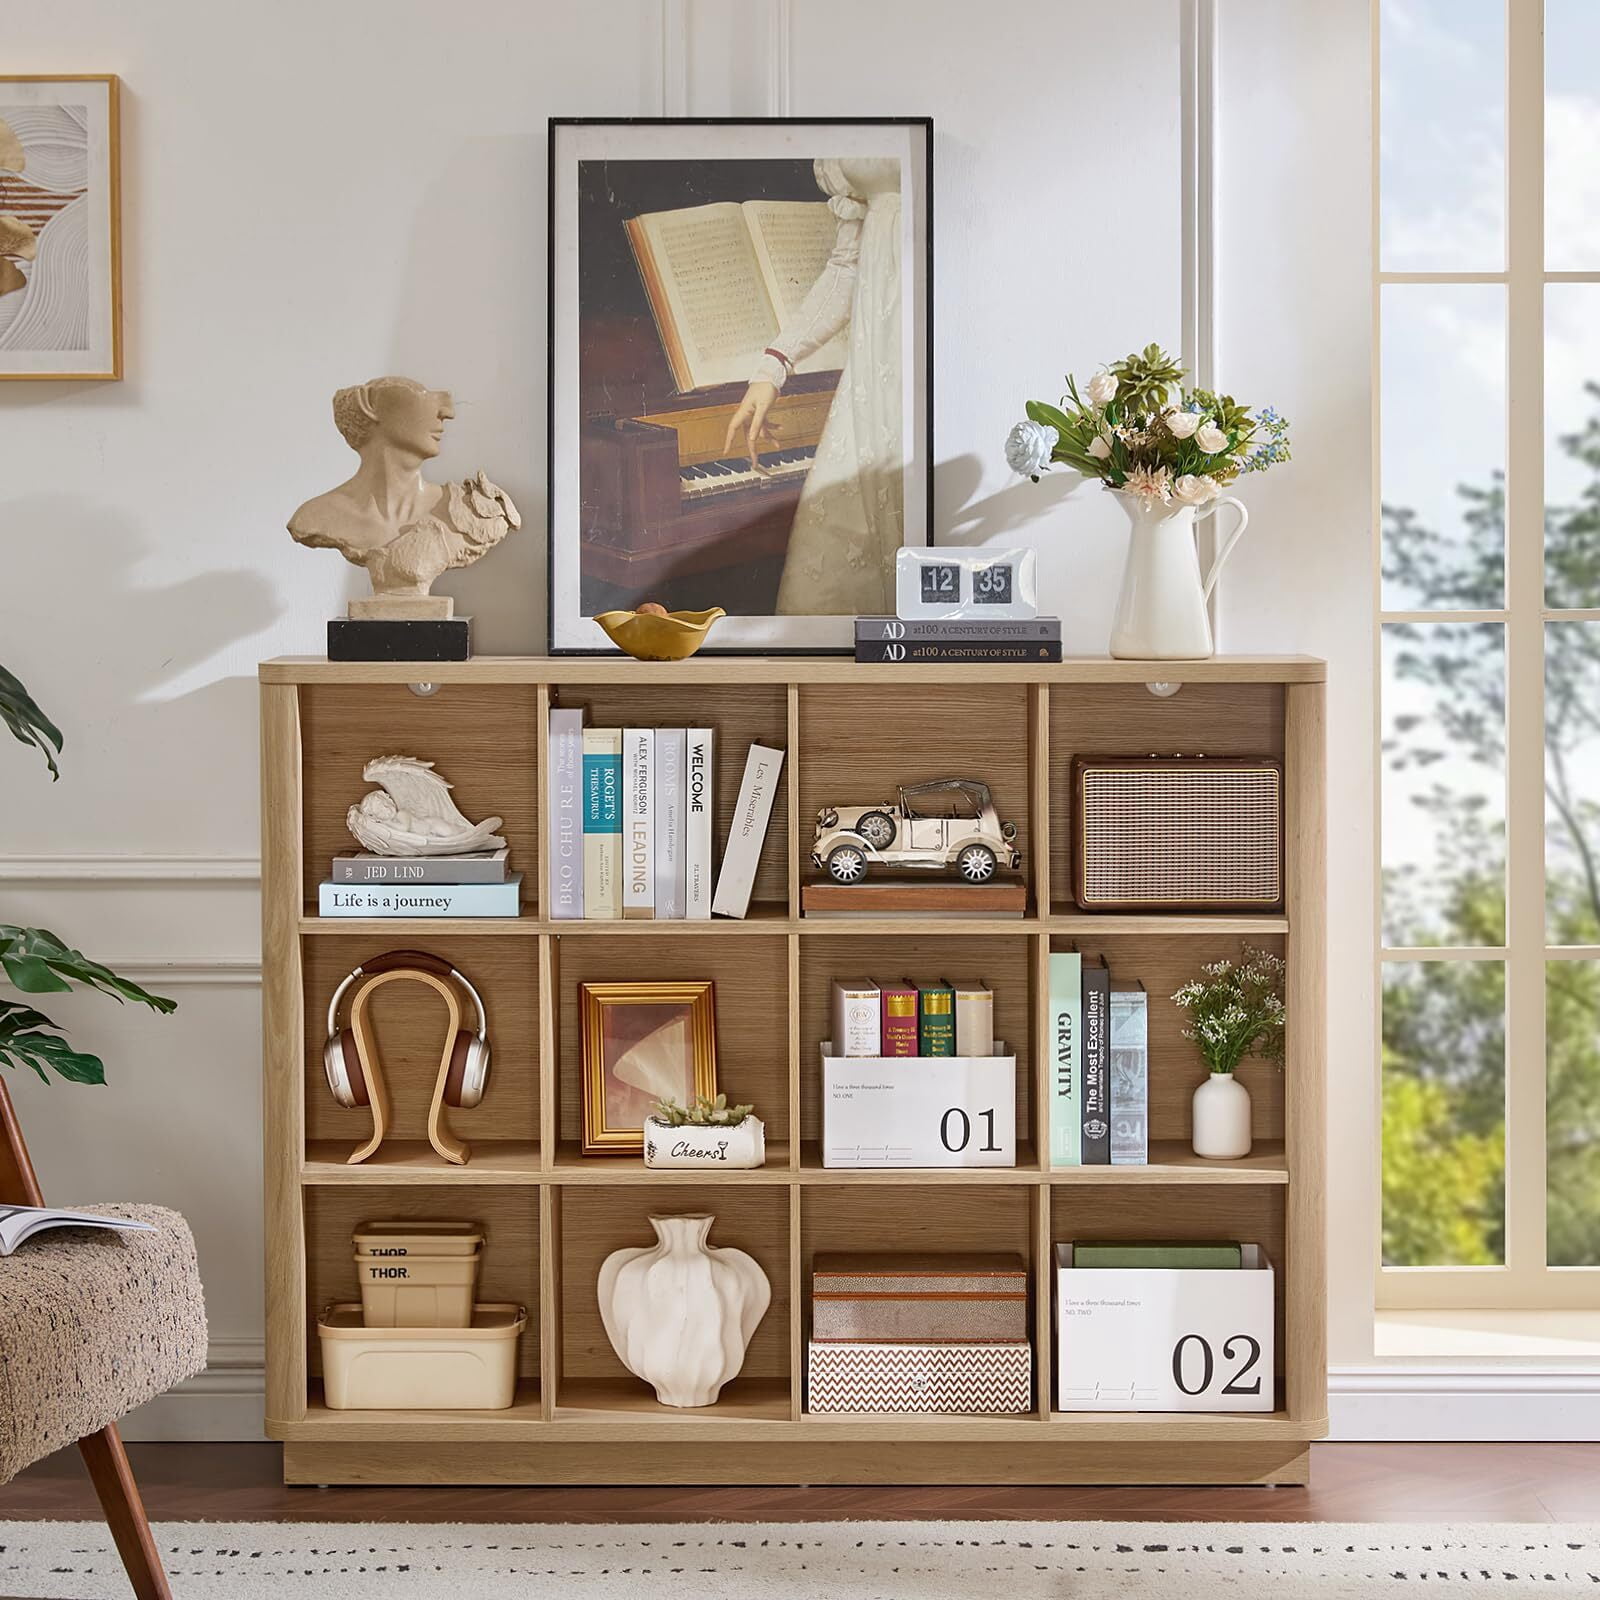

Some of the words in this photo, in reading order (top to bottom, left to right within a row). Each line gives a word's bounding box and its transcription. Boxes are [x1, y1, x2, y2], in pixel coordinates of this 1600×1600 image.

[928, 568, 953, 591] 12
[979, 568, 1005, 592] 35
[882, 622, 906, 639] AD
[882, 644, 906, 661] AD
[912, 647, 938, 656] at100
[639, 736, 647, 760] ALEX
[664, 742, 676, 796] ROOMS
[691, 744, 704, 812] WELCOME
[756, 762, 769, 780] Les
[590, 768, 599, 820] THESAURUS
[604, 768, 615, 820] ROGET'S
[639, 764, 647, 815] FERGUSON
[742, 784, 764, 838] Miserables
[364, 866, 387, 879] JED
[394, 866, 424, 878] LIND
[633, 822, 646, 894] LEADING
[333, 893, 363, 907] Life
[367, 894, 378, 907] is
[383, 898, 391, 907] a
[393, 894, 452, 911] journey
[1087, 990, 1098, 1050] Excellent
[1057, 1012, 1072, 1100] GRAVITY
[1087, 1053, 1098, 1085] Most
[1086, 1088, 1098, 1113] The
[940, 1107, 1003, 1153] 01
[671, 1141, 719, 1159] Cheers
[369, 1267, 410, 1279] THOR.
[1172, 1334, 1261, 1396] 02
